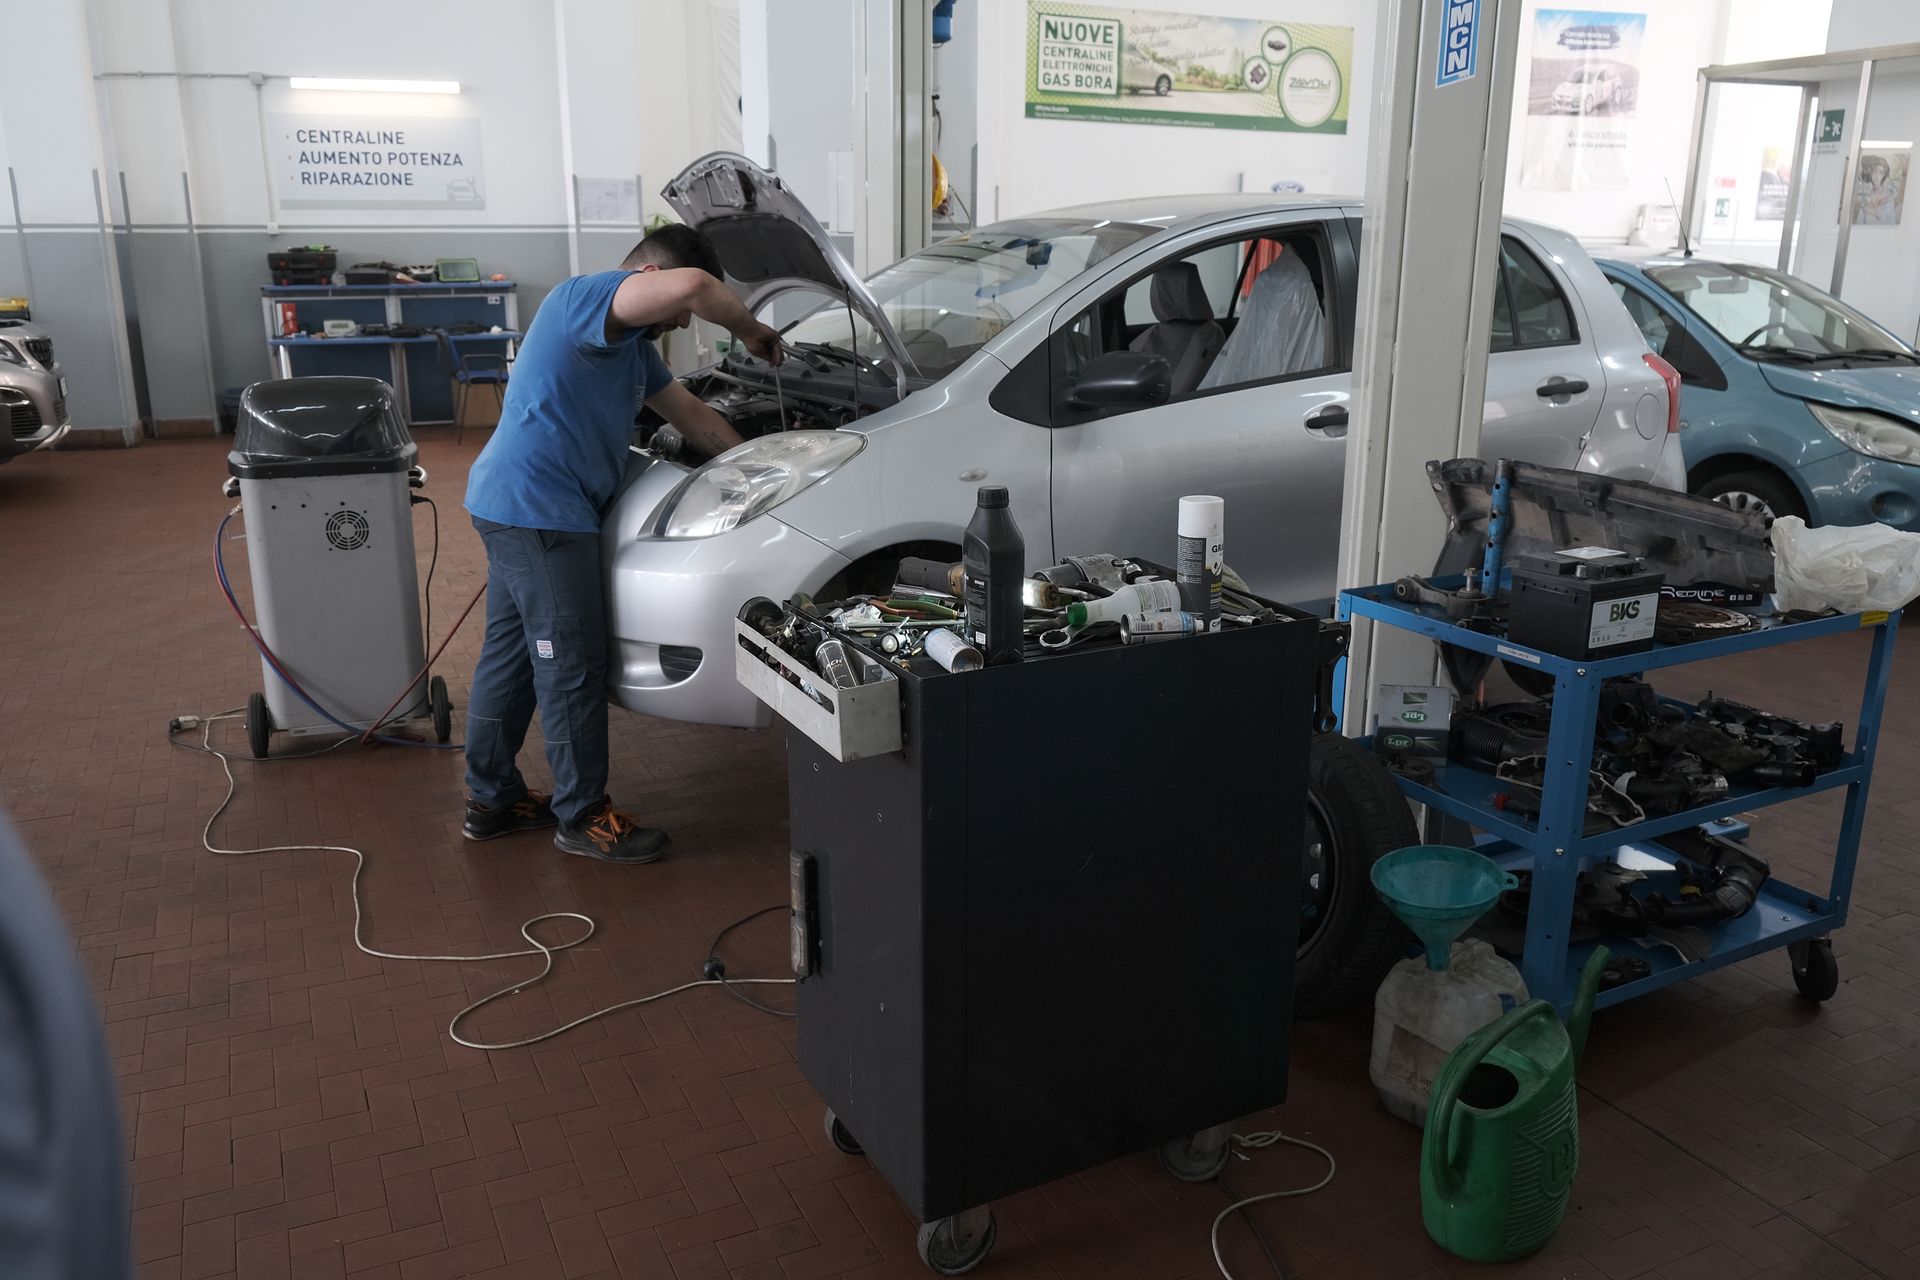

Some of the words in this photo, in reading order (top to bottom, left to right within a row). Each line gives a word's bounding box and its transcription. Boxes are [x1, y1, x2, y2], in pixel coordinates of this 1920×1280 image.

[1044, 20, 1114, 44] NUOVE
[1447, 0, 1473, 73] MCN
[1043, 46, 1114, 61] CENTRALINE
[1042, 59, 1114, 73] ELETTRONICHE
[1042, 72, 1071, 87] GAS
[1074, 74, 1113, 90] BORA
[296, 129, 405, 145] CENTRALINE
[299, 151, 382, 166] AUMENTO
[387, 152, 464, 167] POTENZA
[301, 171, 414, 186] RIPARAZIONE
